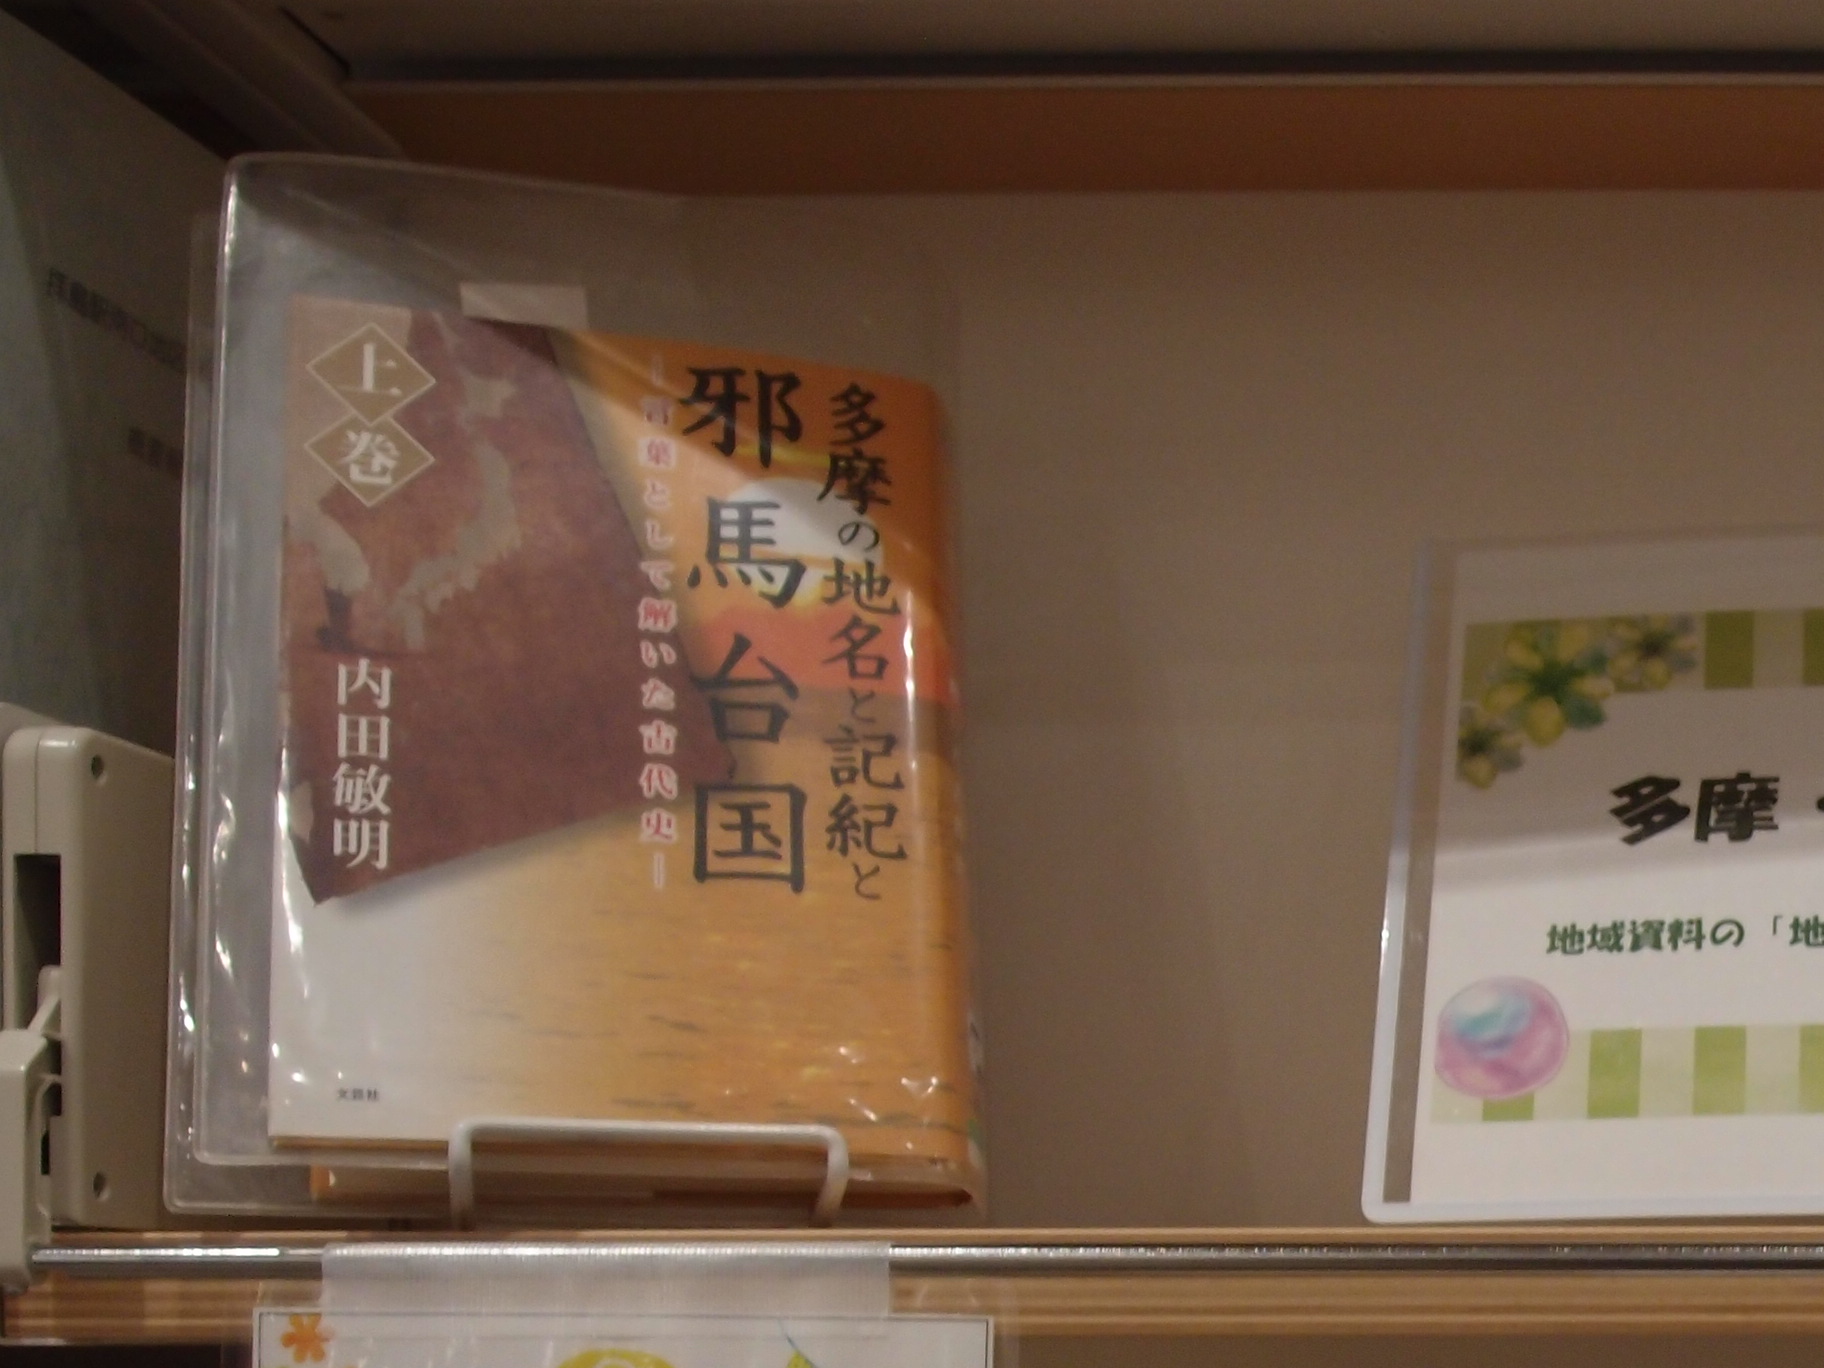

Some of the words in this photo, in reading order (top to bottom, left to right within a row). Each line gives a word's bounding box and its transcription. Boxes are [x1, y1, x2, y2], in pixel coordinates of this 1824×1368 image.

[342, 344, 402, 488] 上巻
[332, 657, 394, 870] 内田敏明
[681, 367, 806, 892] 邪馬台国
[817, 382, 907, 898] 多摩の地名と記紀と
